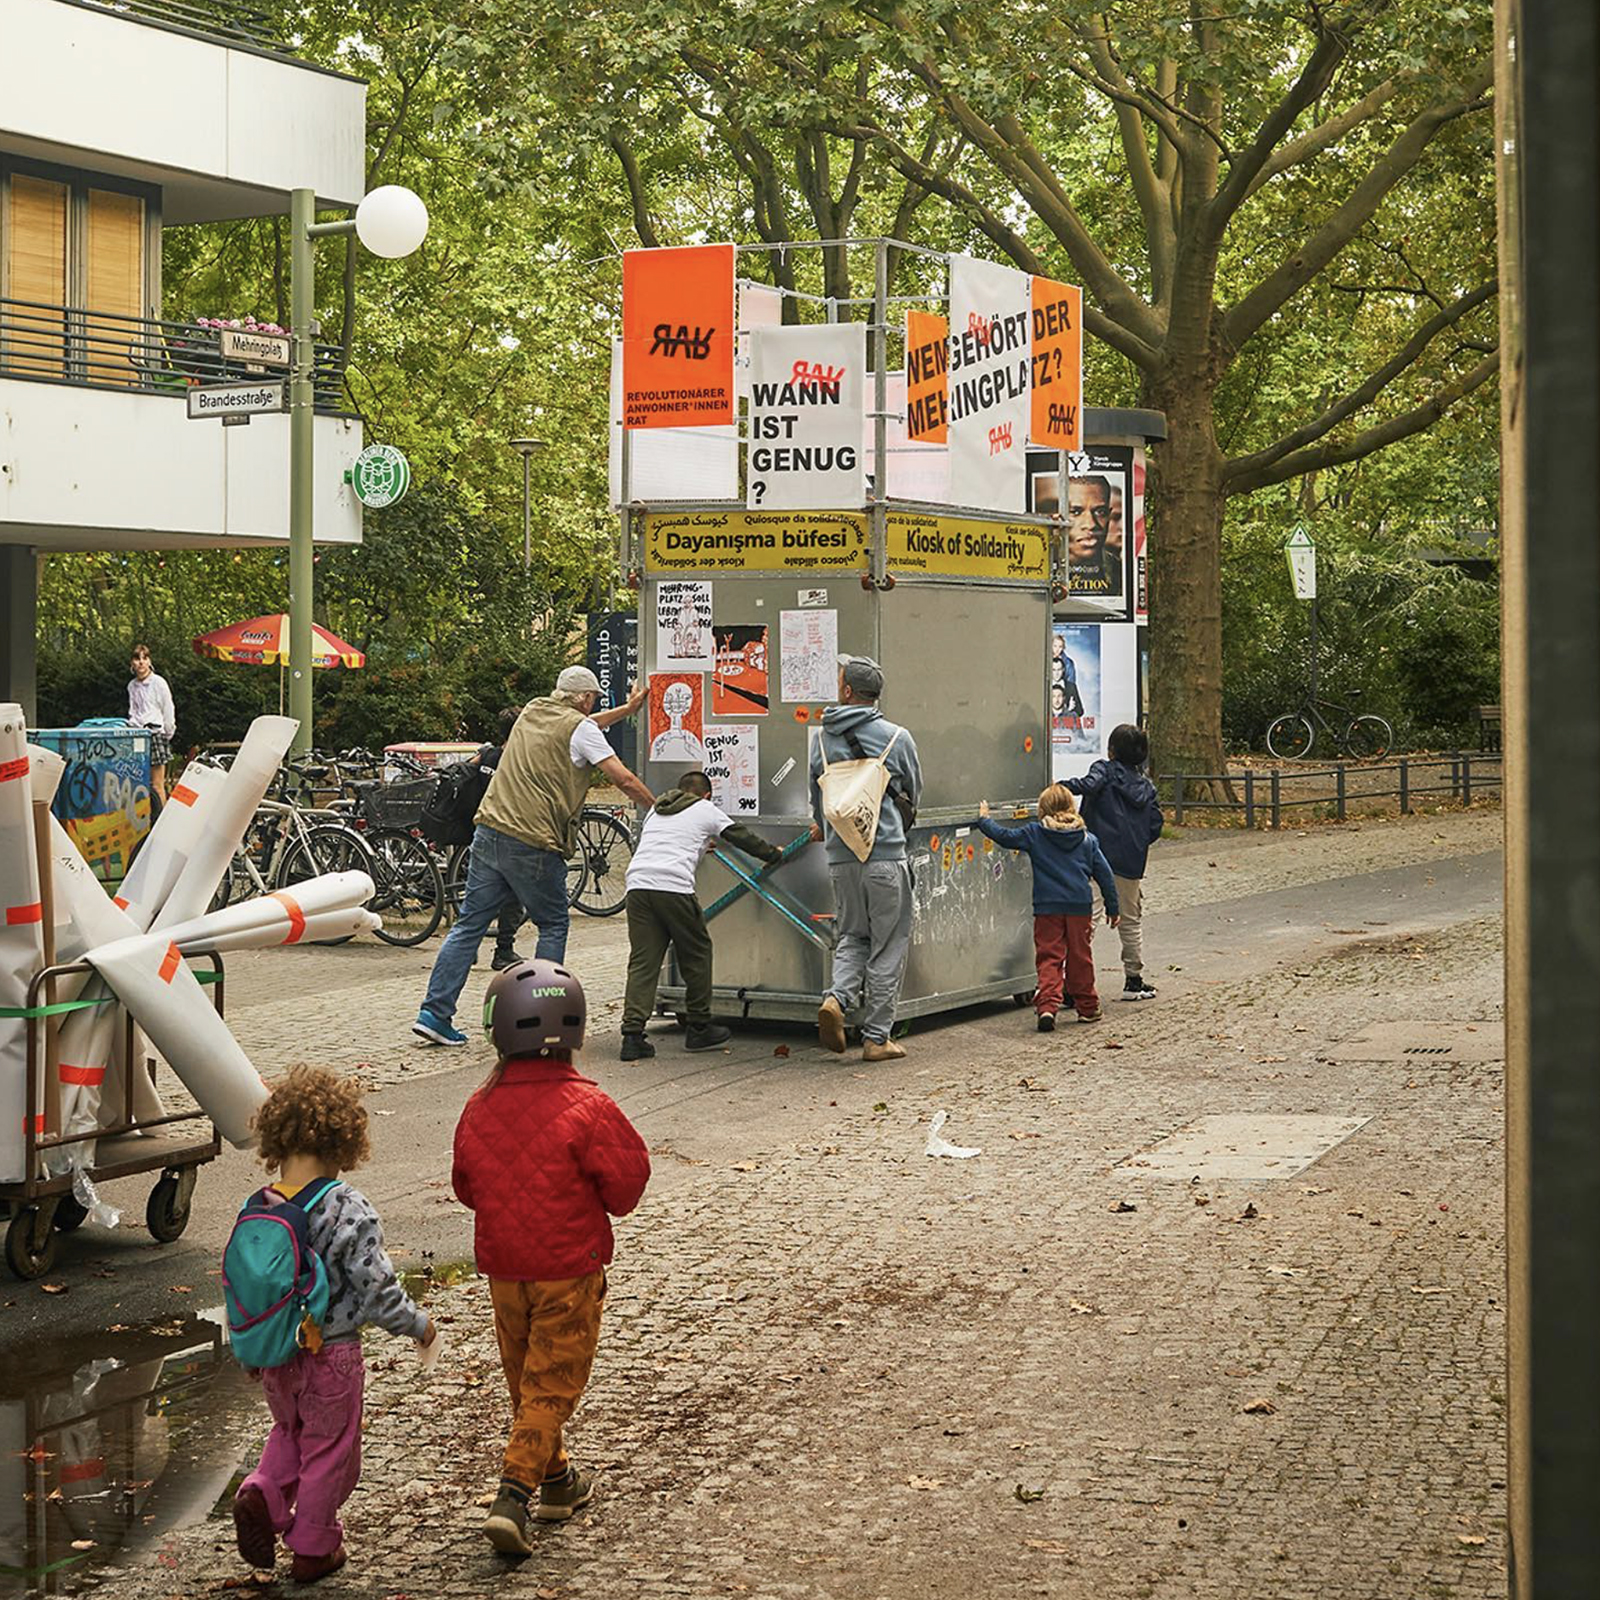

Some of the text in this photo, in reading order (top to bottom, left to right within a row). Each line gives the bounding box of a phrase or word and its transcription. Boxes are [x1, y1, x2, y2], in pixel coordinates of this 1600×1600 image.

[1033, 299, 1072, 342] DER
[232, 335, 283, 359] Mehringplatz
[951, 311, 1028, 372] GEHÖRT
[199, 389, 273, 408] Brandesstraße
[626, 388, 726, 402] REVOLUTIONÄRER
[752, 382, 841, 407] WANN
[626, 416, 648, 426] RAT
[753, 415, 799, 440] IST
[752, 446, 856, 472] GENUG
[1068, 456, 1085, 471] Y
[752, 481, 767, 505] ?
[744, 515, 791, 525] Quiosque
[793, 515, 806, 523] da
[666, 527, 848, 554] Dayanışma büfesi
[907, 528, 1026, 565] Kiosk of Solidarity
[699, 558, 717, 568] der
[717, 558, 746, 568] Kiosk
[597, 630, 610, 664] hub
[704, 735, 739, 749] GENUG
[708, 750, 723, 763] IST
[532, 987, 567, 998] uvex
